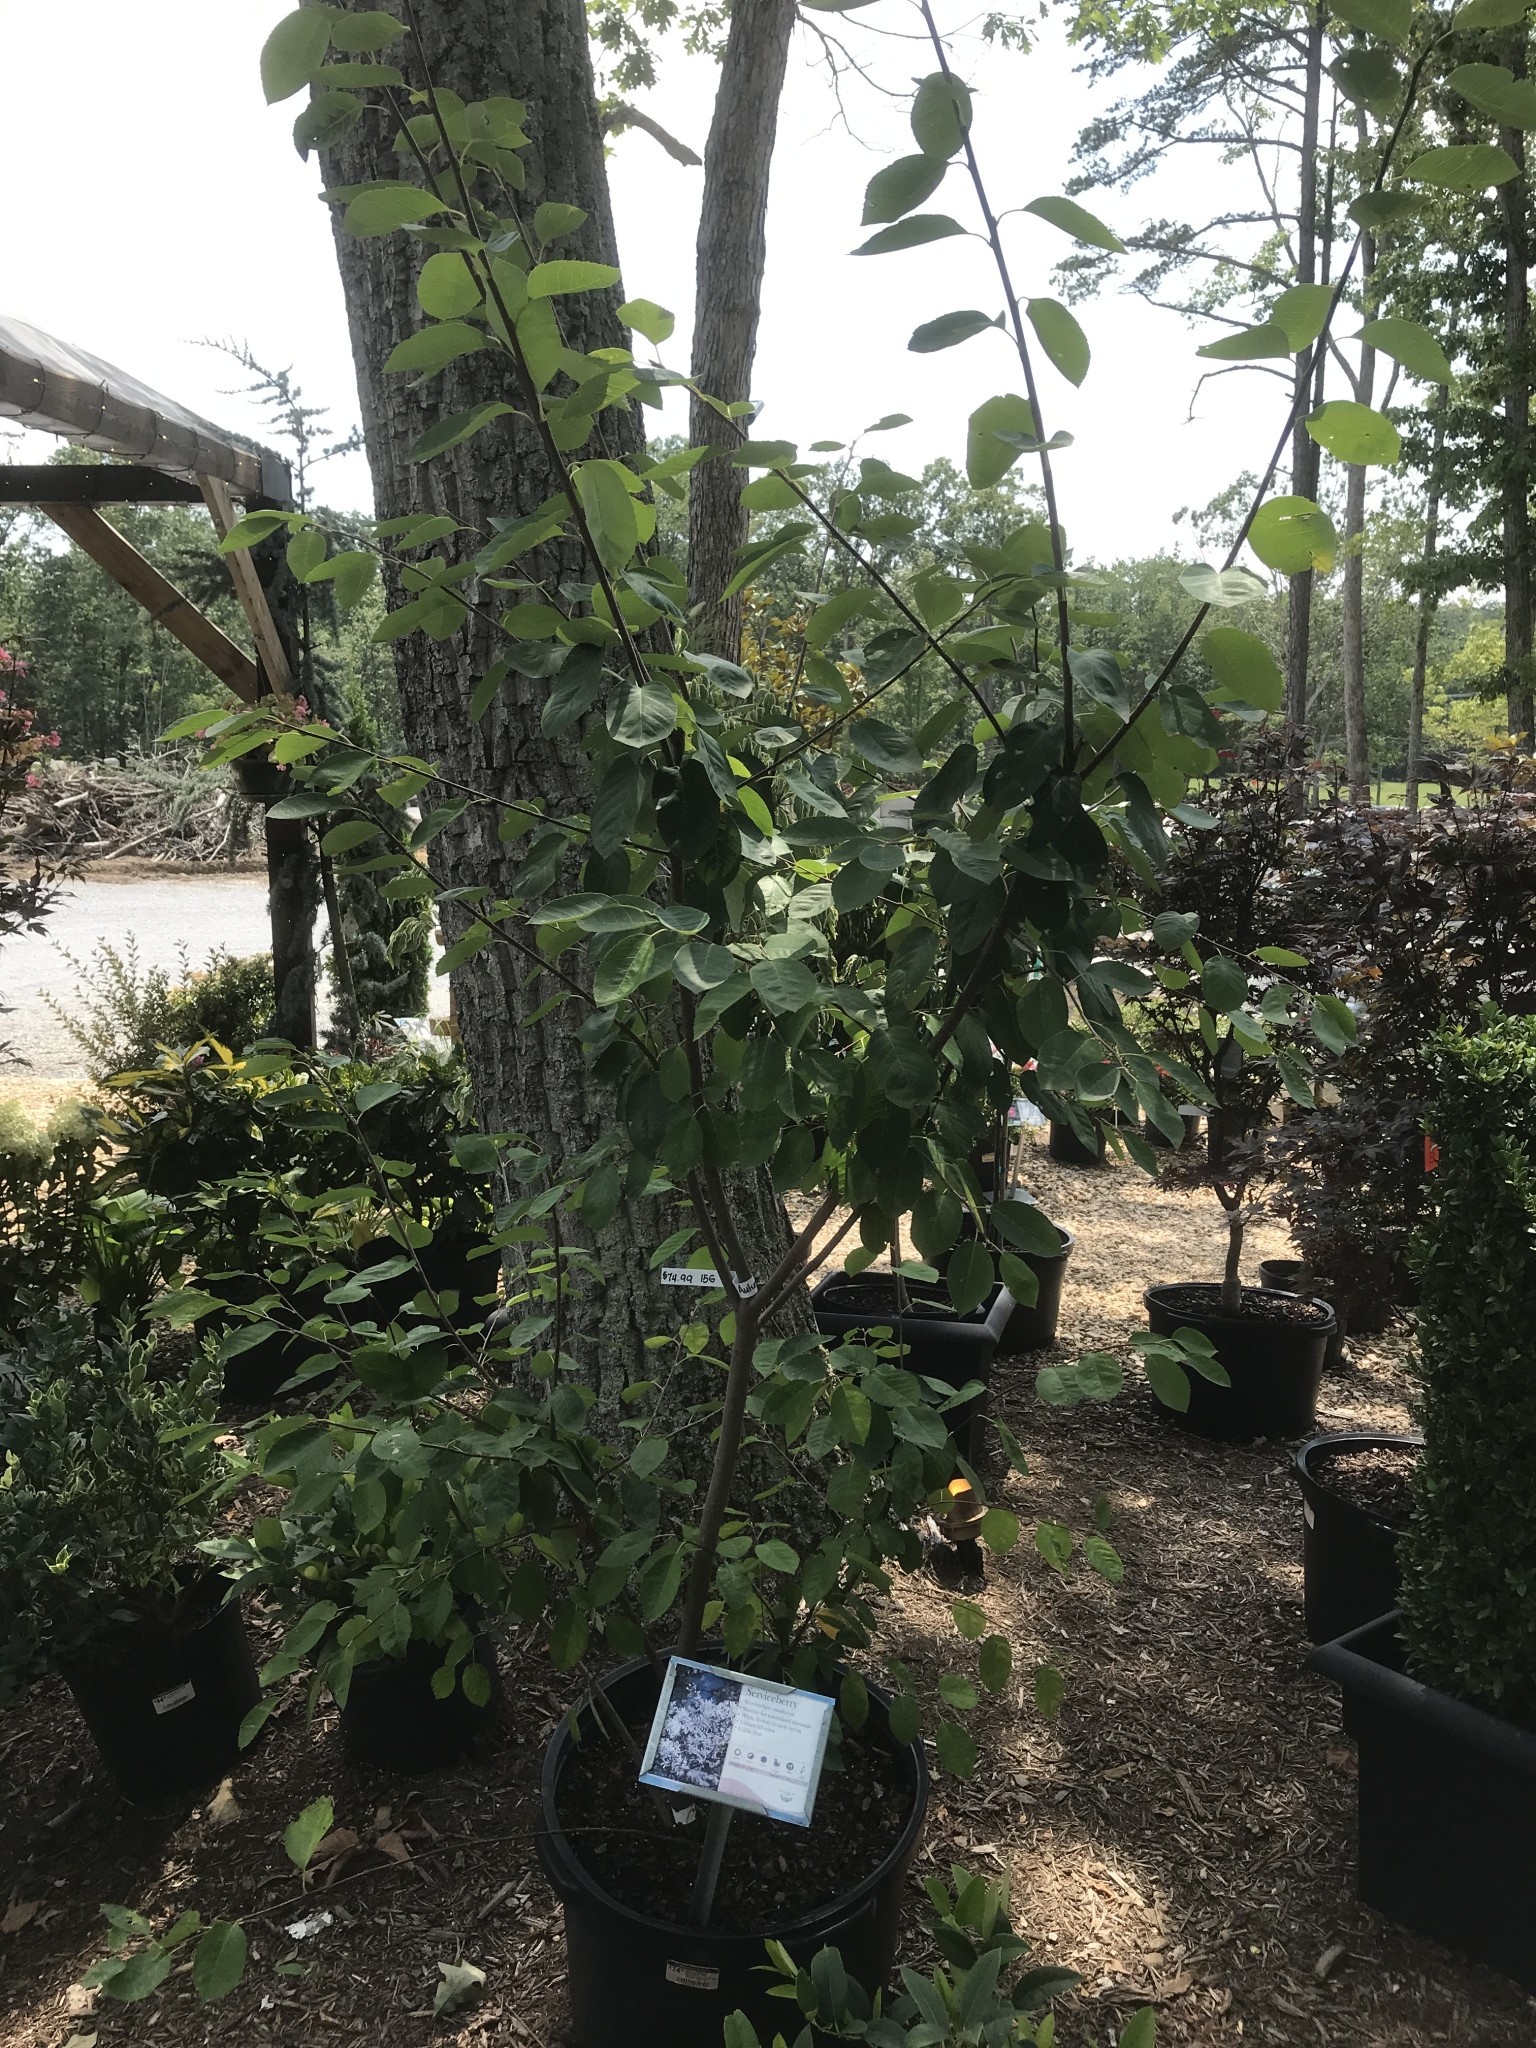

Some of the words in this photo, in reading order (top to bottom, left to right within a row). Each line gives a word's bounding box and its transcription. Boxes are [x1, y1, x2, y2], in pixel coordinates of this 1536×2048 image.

[662, 1271, 693, 1284] $74.99
[700, 1273, 716, 1284] 15G
[746, 1686, 798, 1709] Serviceberry
